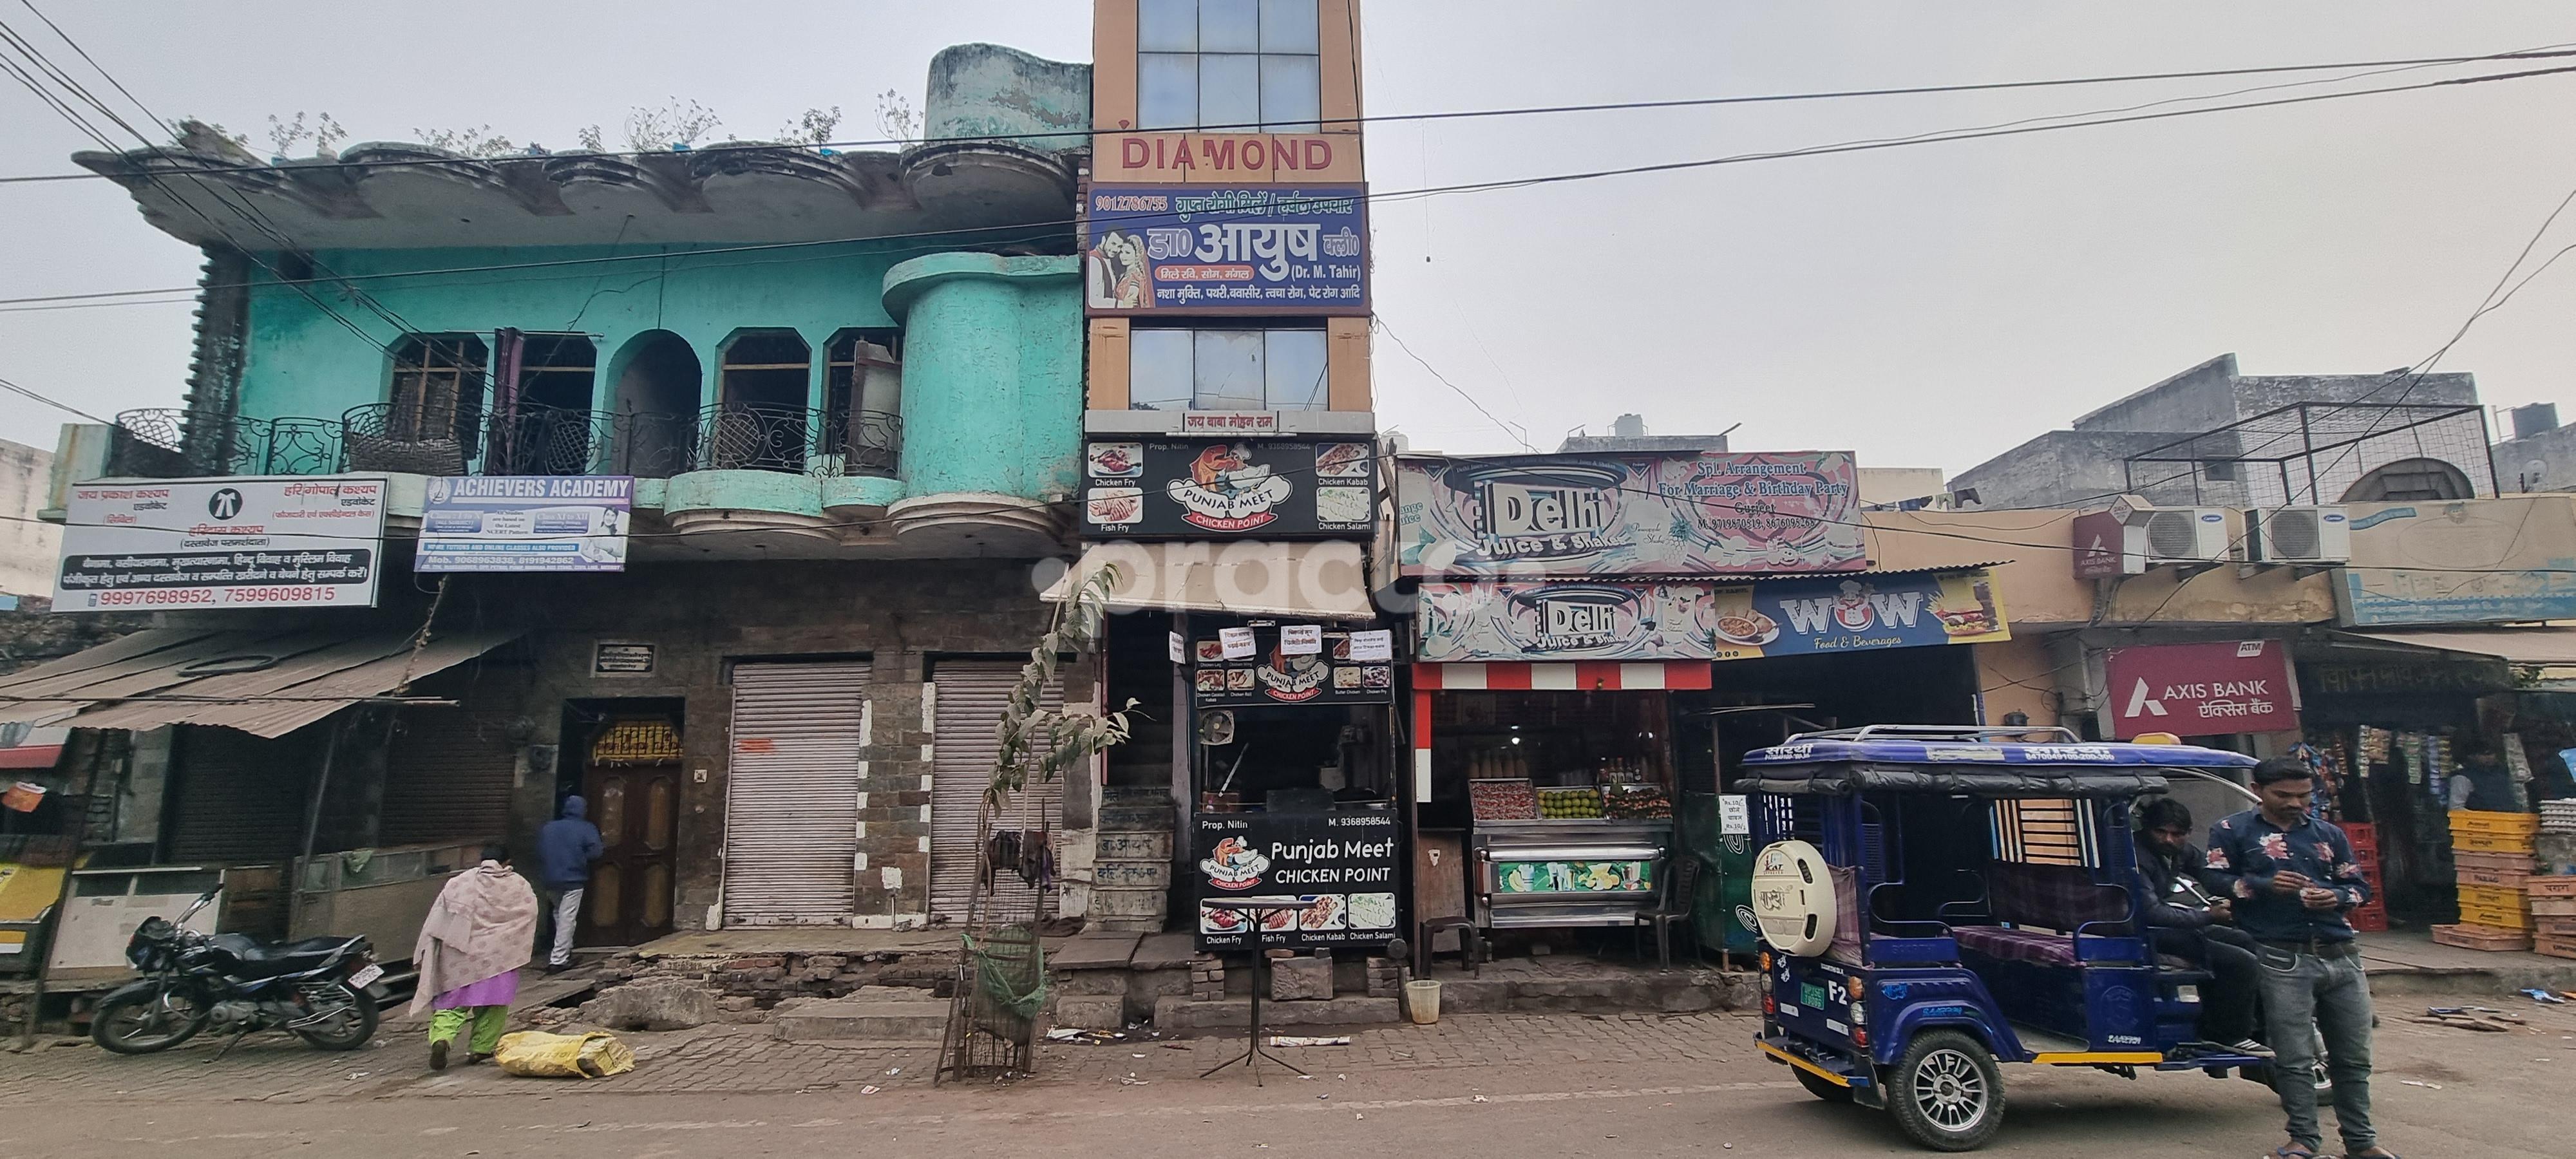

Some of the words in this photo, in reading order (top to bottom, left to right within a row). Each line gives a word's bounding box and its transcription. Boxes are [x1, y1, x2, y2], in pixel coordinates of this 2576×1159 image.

[1122, 138, 1332, 171] DIAMOND
[1095, 195, 1168, 211] 9012786755
[1195, 223, 1321, 281] आयुष
[1160, 267, 1180, 280] मिले
[1182, 267, 1198, 280] रवि,
[1202, 268, 1222, 280] सोम,
[1224, 267, 1250, 279] मंगल
[1291, 265, 1311, 281] (Dr.
[1313, 265, 1326, 279] M.
[1329, 265, 1361, 281] Tahir)
[1157, 288, 1175, 299] नशा
[1265, 288, 1285, 299] त्वचा
[1288, 285, 1306, 299] रोग,
[1309, 284, 1321, 299] पेट
[1323, 284, 1338, 299] रोग
[1340, 284, 1361, 299] आदि
[1187, 415, 1206, 428] जय
[1208, 415, 1226, 428] बाबा
[1257, 415, 1273, 428] राम
[1697, 462, 1721, 477] Spl.
[1725, 461, 1807, 478] Arrangement
[343, 485, 377, 495] कश्यप
[453, 478, 546, 497] ACHIEVERS
[549, 479, 629, 497] ACADEMY
[1124, 479, 1136, 488] Fry
[1658, 482, 1681, 496] For
[1683, 482, 1739, 498] Marriage
[1744, 482, 1757, 496] &
[1758, 482, 1814, 498] Birthday
[1816, 481, 1848, 498] Party
[341, 496, 375, 506] एडवोकेट
[1184, 489, 1235, 509] PUNJAB
[1239, 489, 1274, 509] MEET
[1489, 483, 1604, 536] Delhi
[1117, 524, 1130, 533] Fry
[1195, 515, 1235, 529] CHICKEN
[1237, 514, 1265, 528] POINT
[1477, 536, 1545, 556] Juice
[1551, 535, 1567, 551] &
[2096, 556, 2117, 565] BANK
[100, 589, 217, 606] 9997698952,
[224, 587, 335, 603] 7599609815
[1546, 601, 1617, 636] Delhi
[1814, 636, 1838, 650] Food
[1840, 637, 1850, 648] &
[1852, 635, 1902, 650] Beverages
[2240, 643, 2262, 652] ATM
[1265, 672, 1296, 686] PUNJAB
[1298, 670, 1320, 686] MEET
[1273, 690, 1297, 700] CHICKEN
[1298, 690, 1314, 700] POINT
[2163, 683, 2207, 701] AXIS
[2212, 679, 2269, 698] BANK
[2197, 699, 2248, 718] ऐक्सिस
[2249, 697, 2273, 714] बैंक
[1202, 820, 1226, 831] Prop.
[1227, 820, 1248, 829] Nitin
[1328, 818, 1339, 827] M.
[1341, 816, 1391, 827] 9368958544
[1271, 838, 1340, 864] Punjab
[1344, 836, 1394, 859] Meet
[1209, 864, 1238, 877] PUNJAB
[1240, 863, 1260, 876] MEET
[1275, 869, 1340, 884] CHICKEN
[1345, 867, 1391, 883] POINT
[1215, 879, 1238, 889] CHICKEN
[1238, 878, 1256, 888] POINT
[1206, 936, 1231, 945] Chicken
[1231, 936, 1242, 945] Fry
[1262, 934, 1274, 943] Fish
[1276, 934, 1286, 944] Fry
[1301, 933, 1325, 941] Chicken
[1326, 932, 1346, 941] Kabab
[1349, 932, 1374, 940] Chicken
[1375, 931, 1396, 939] Salami
[1828, 979, 1848, 1005] F2
